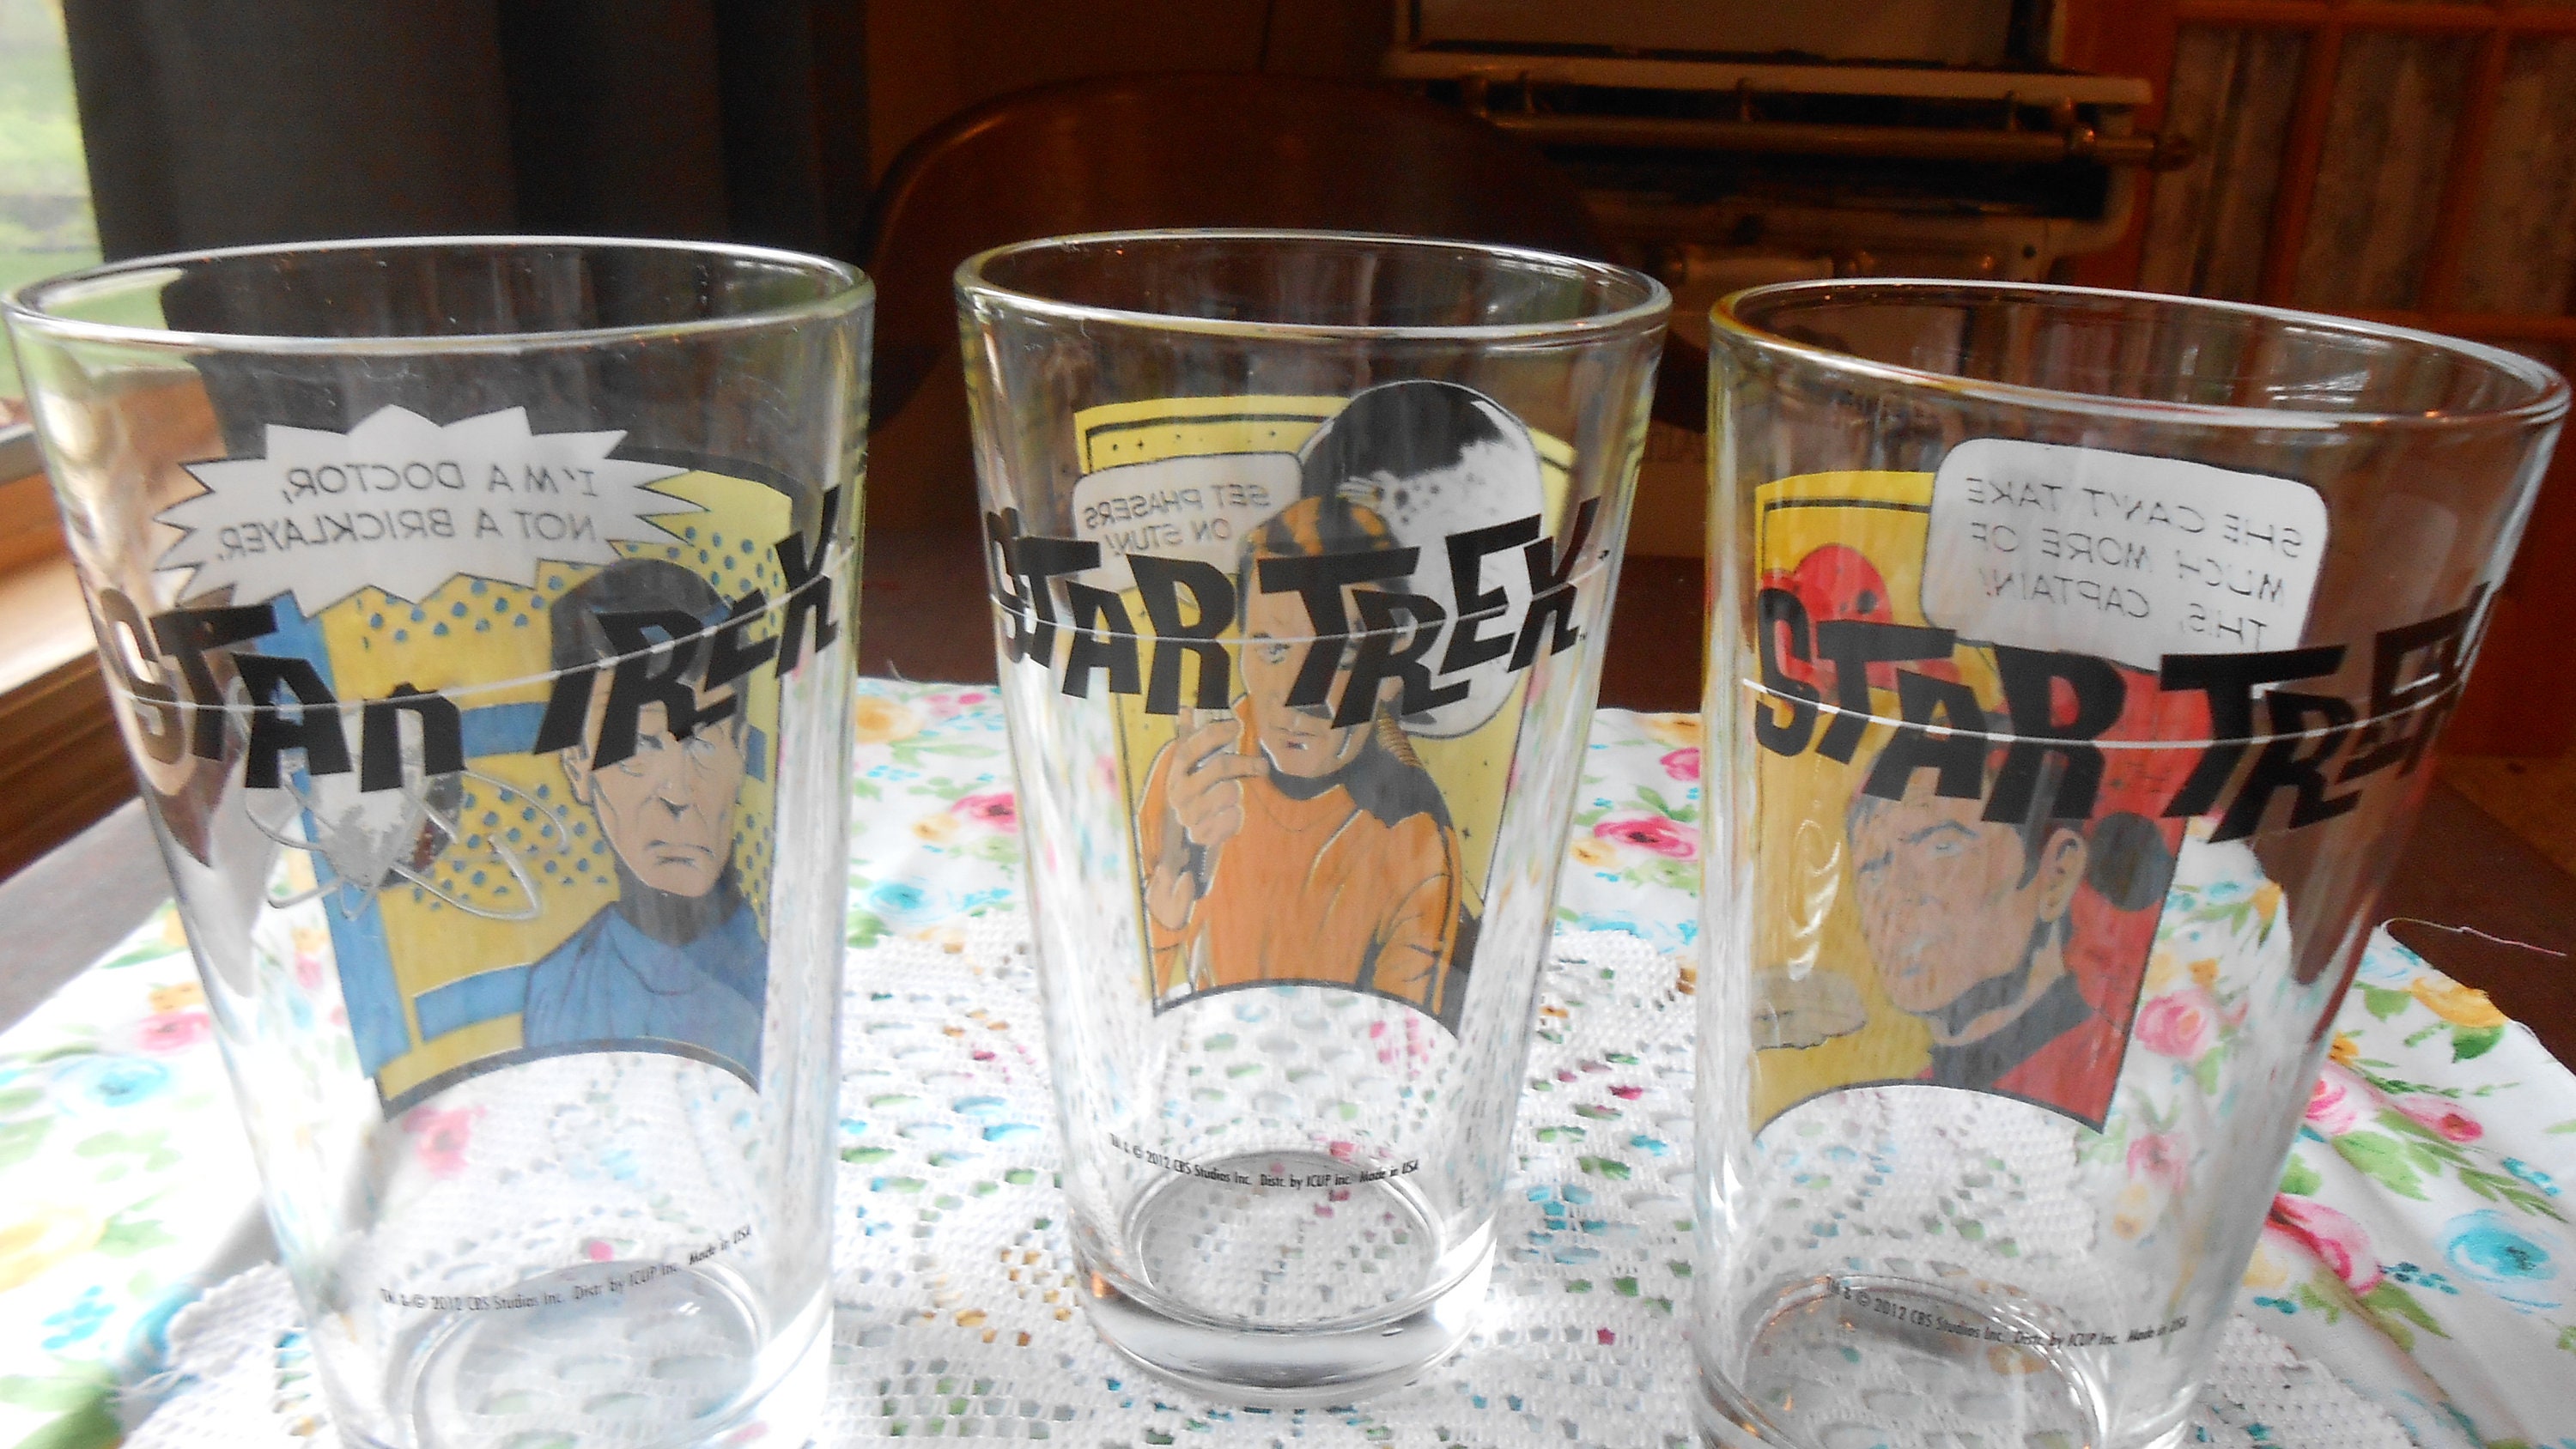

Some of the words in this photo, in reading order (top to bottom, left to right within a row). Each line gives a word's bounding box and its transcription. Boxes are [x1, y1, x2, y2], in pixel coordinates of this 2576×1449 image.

[986, 506, 1237, 715] STAR
[1257, 497, 1601, 730] TREK
[1754, 588, 2126, 823] STAR
[1145, 1149, 1170, 1170] 2012
[1173, 1159, 1192, 1174] CBS
[1194, 1164, 1231, 1183] Studios
[1290, 1173, 1303, 1191] by
[1307, 1173, 1332, 1188] ICUP
[1359, 1170, 1386, 1184] Made
